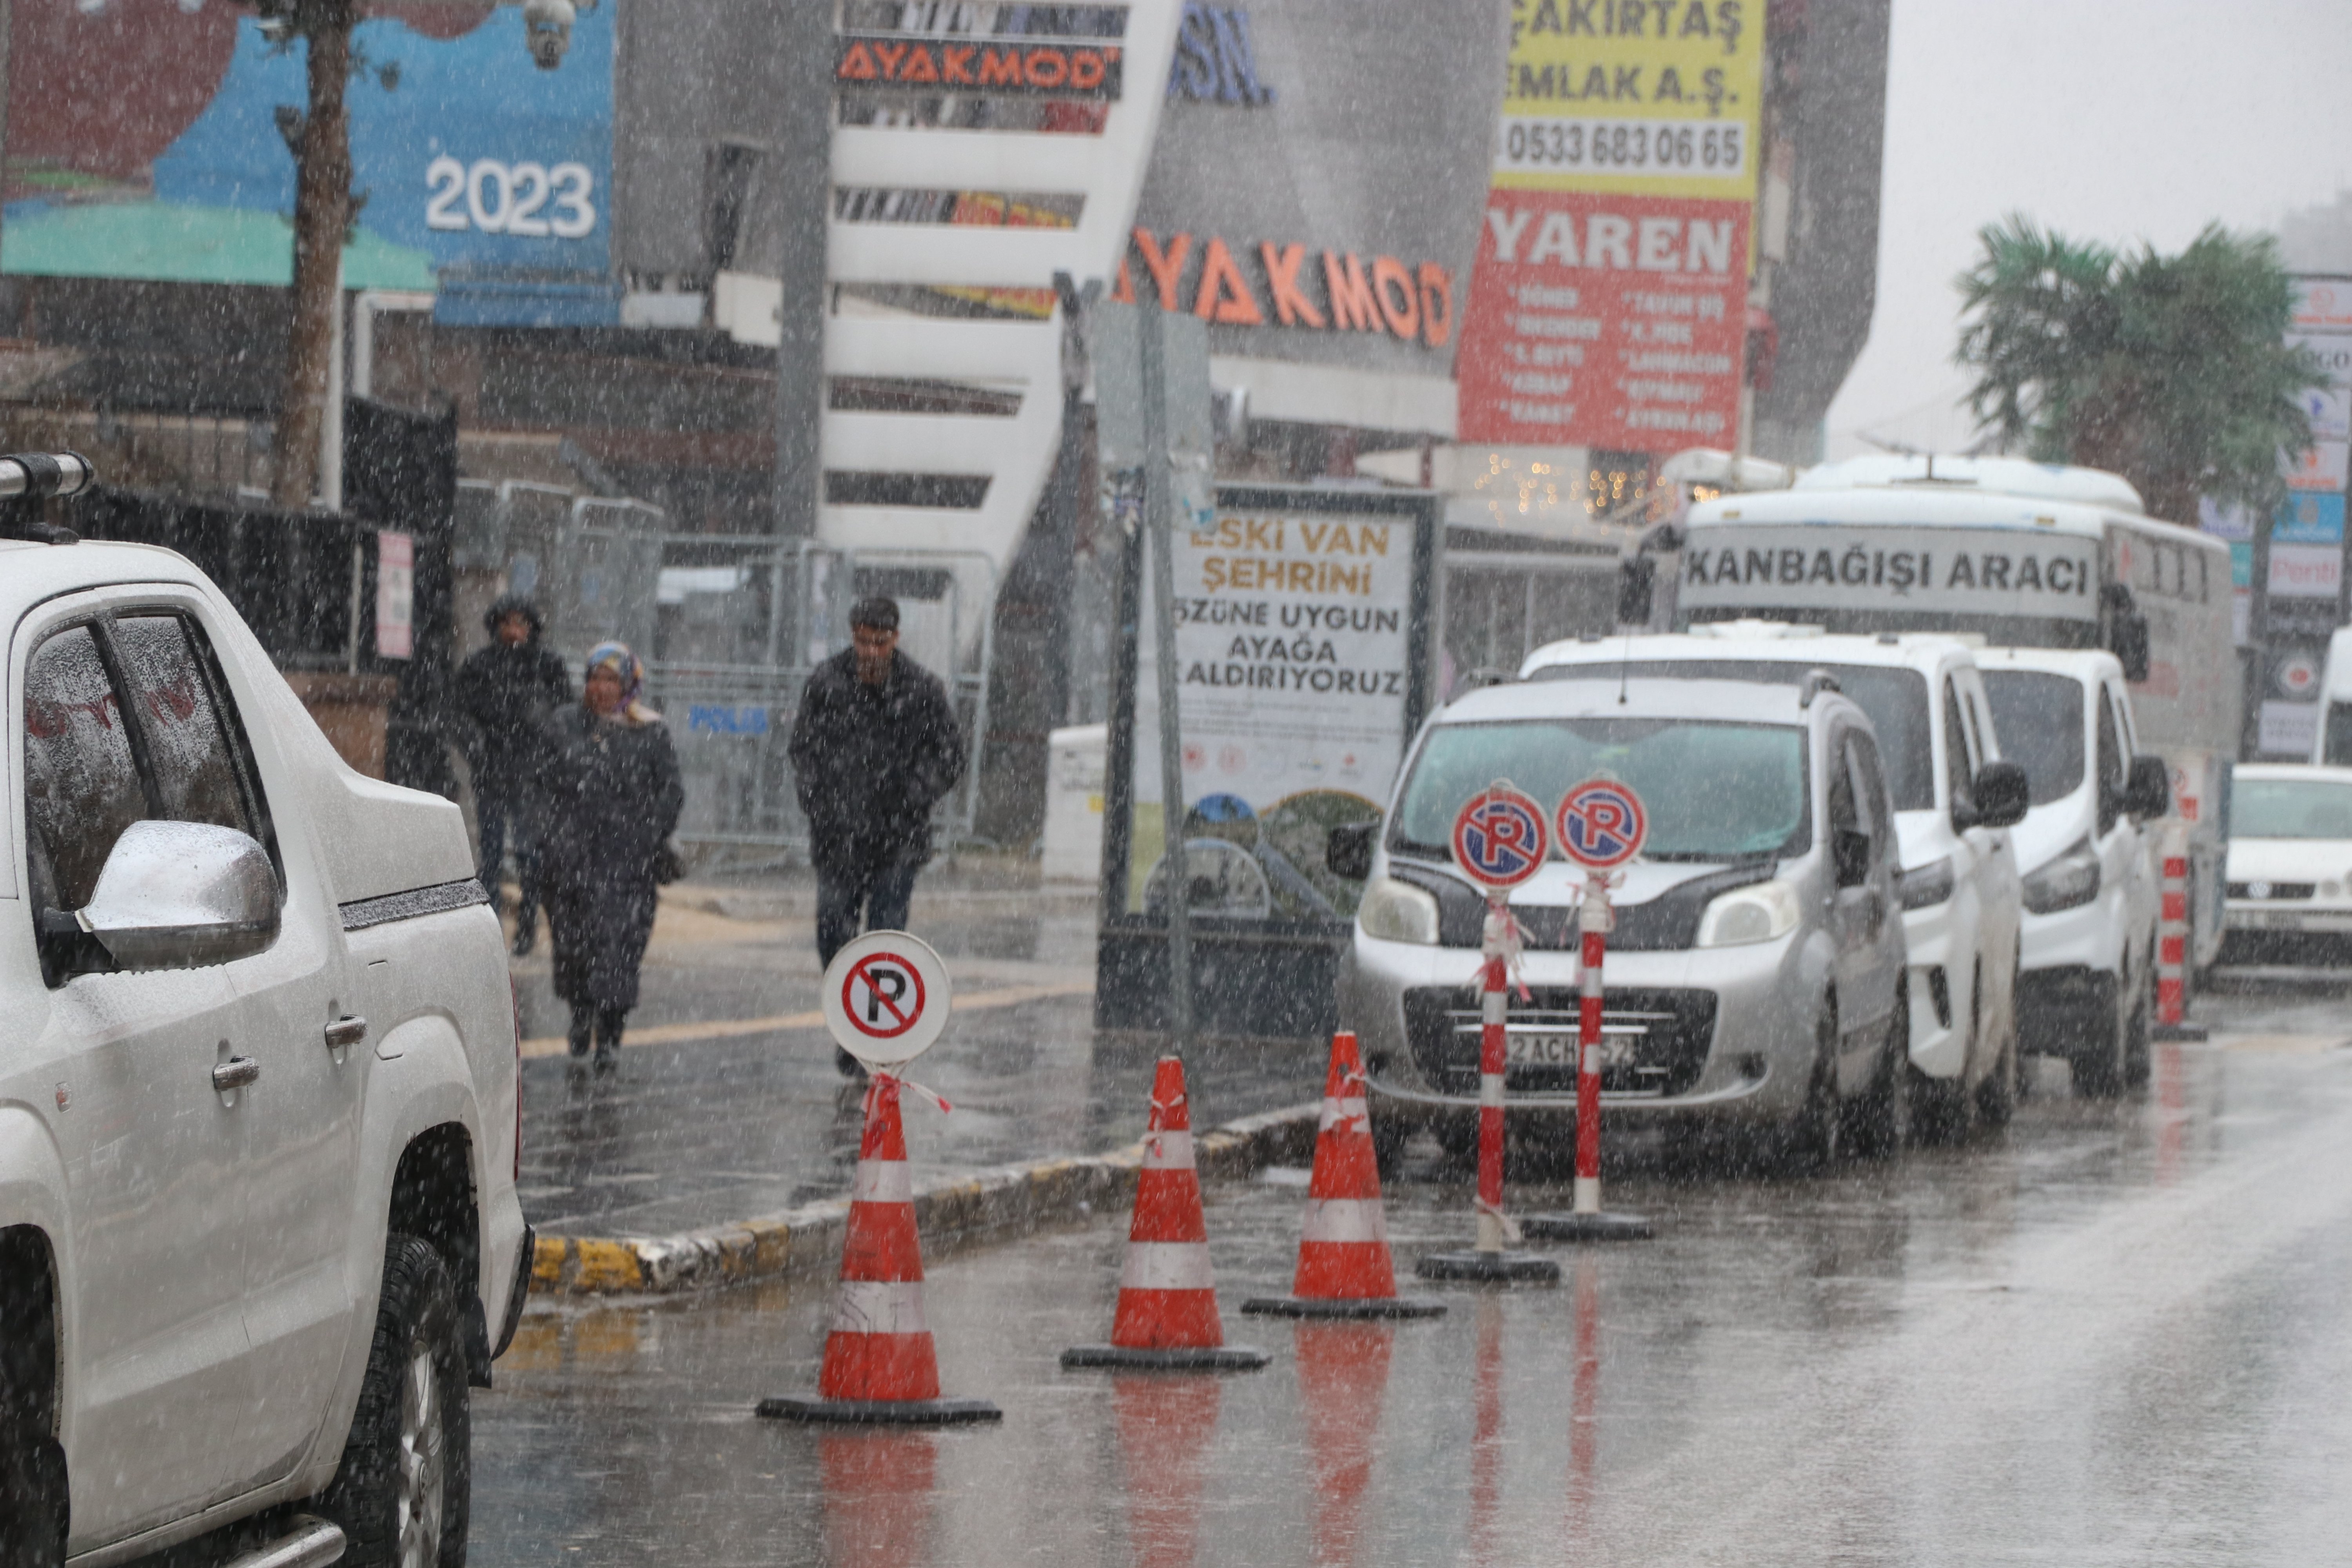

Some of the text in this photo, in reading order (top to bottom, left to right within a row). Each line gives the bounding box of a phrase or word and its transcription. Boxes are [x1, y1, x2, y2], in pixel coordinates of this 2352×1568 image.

[1507, 124, 1740, 167] 0533 683 06 65
[426, 155, 596, 238] 2023
[1486, 209, 1735, 274] YAREN
[1299, 521, 1390, 556] VAN
[1202, 555, 1372, 595] ŞEHRİNİ
[1687, 543, 2088, 596] KANBAĞIŞI ARACI
[1280, 602, 1400, 633] UYGUN
[1228, 631, 1337, 665] AYAĞA
[1174, 659, 1401, 695] ALDIRIYORUZ
